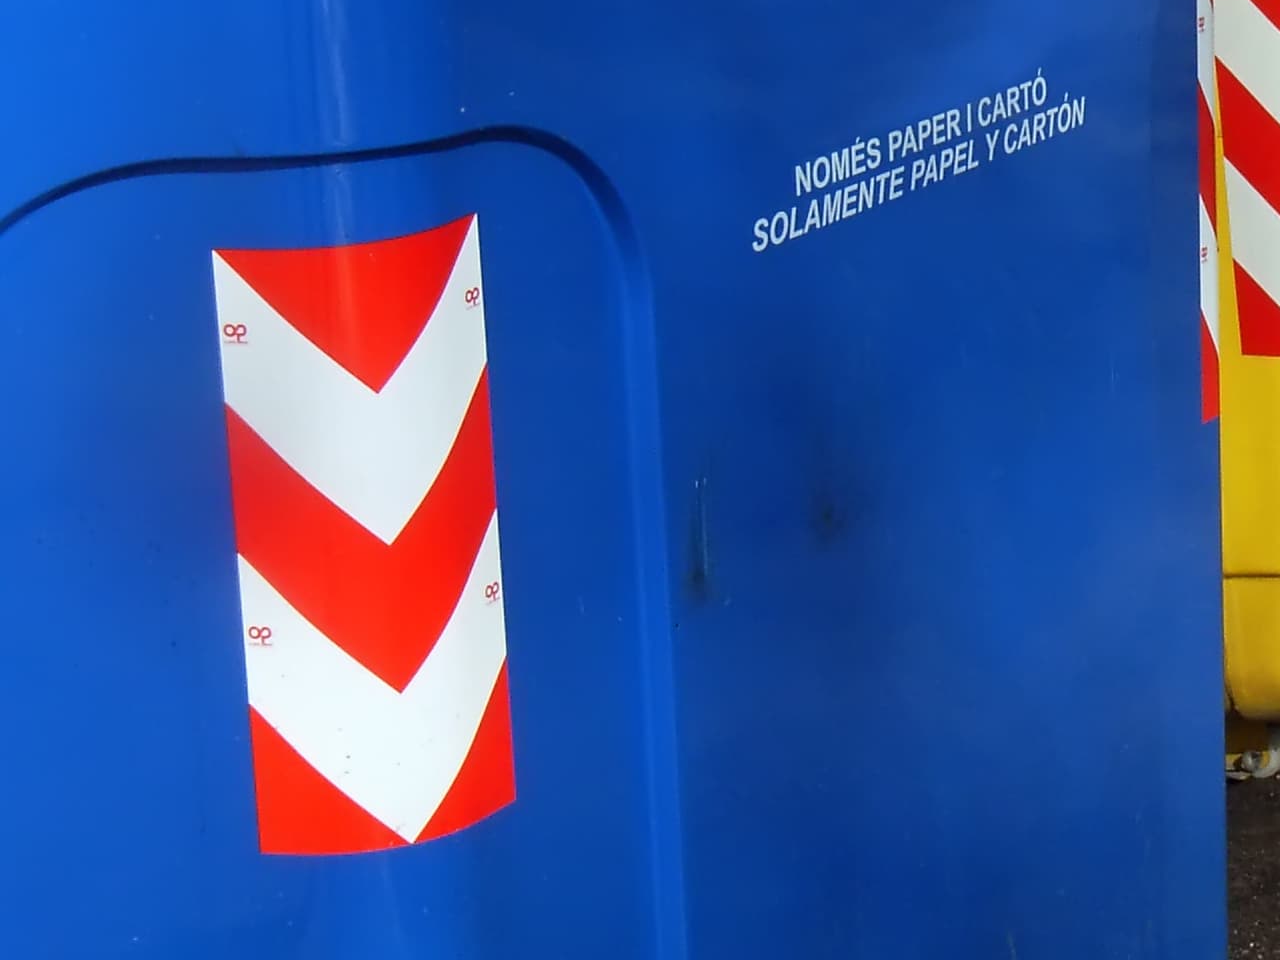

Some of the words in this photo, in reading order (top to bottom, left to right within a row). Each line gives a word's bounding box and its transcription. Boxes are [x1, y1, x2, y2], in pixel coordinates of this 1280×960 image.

[752, 165, 905, 252] SOLAMENTE
[910, 139, 979, 191] PAPEL
[985, 129, 1000, 161] Y
[1003, 92, 1086, 154] CARTÓN
[795, 136, 881, 197] NOMÉS
[888, 108, 962, 162] PAPER
[967, 103, 973, 133] I
[977, 68, 1047, 127] CARTÓ
